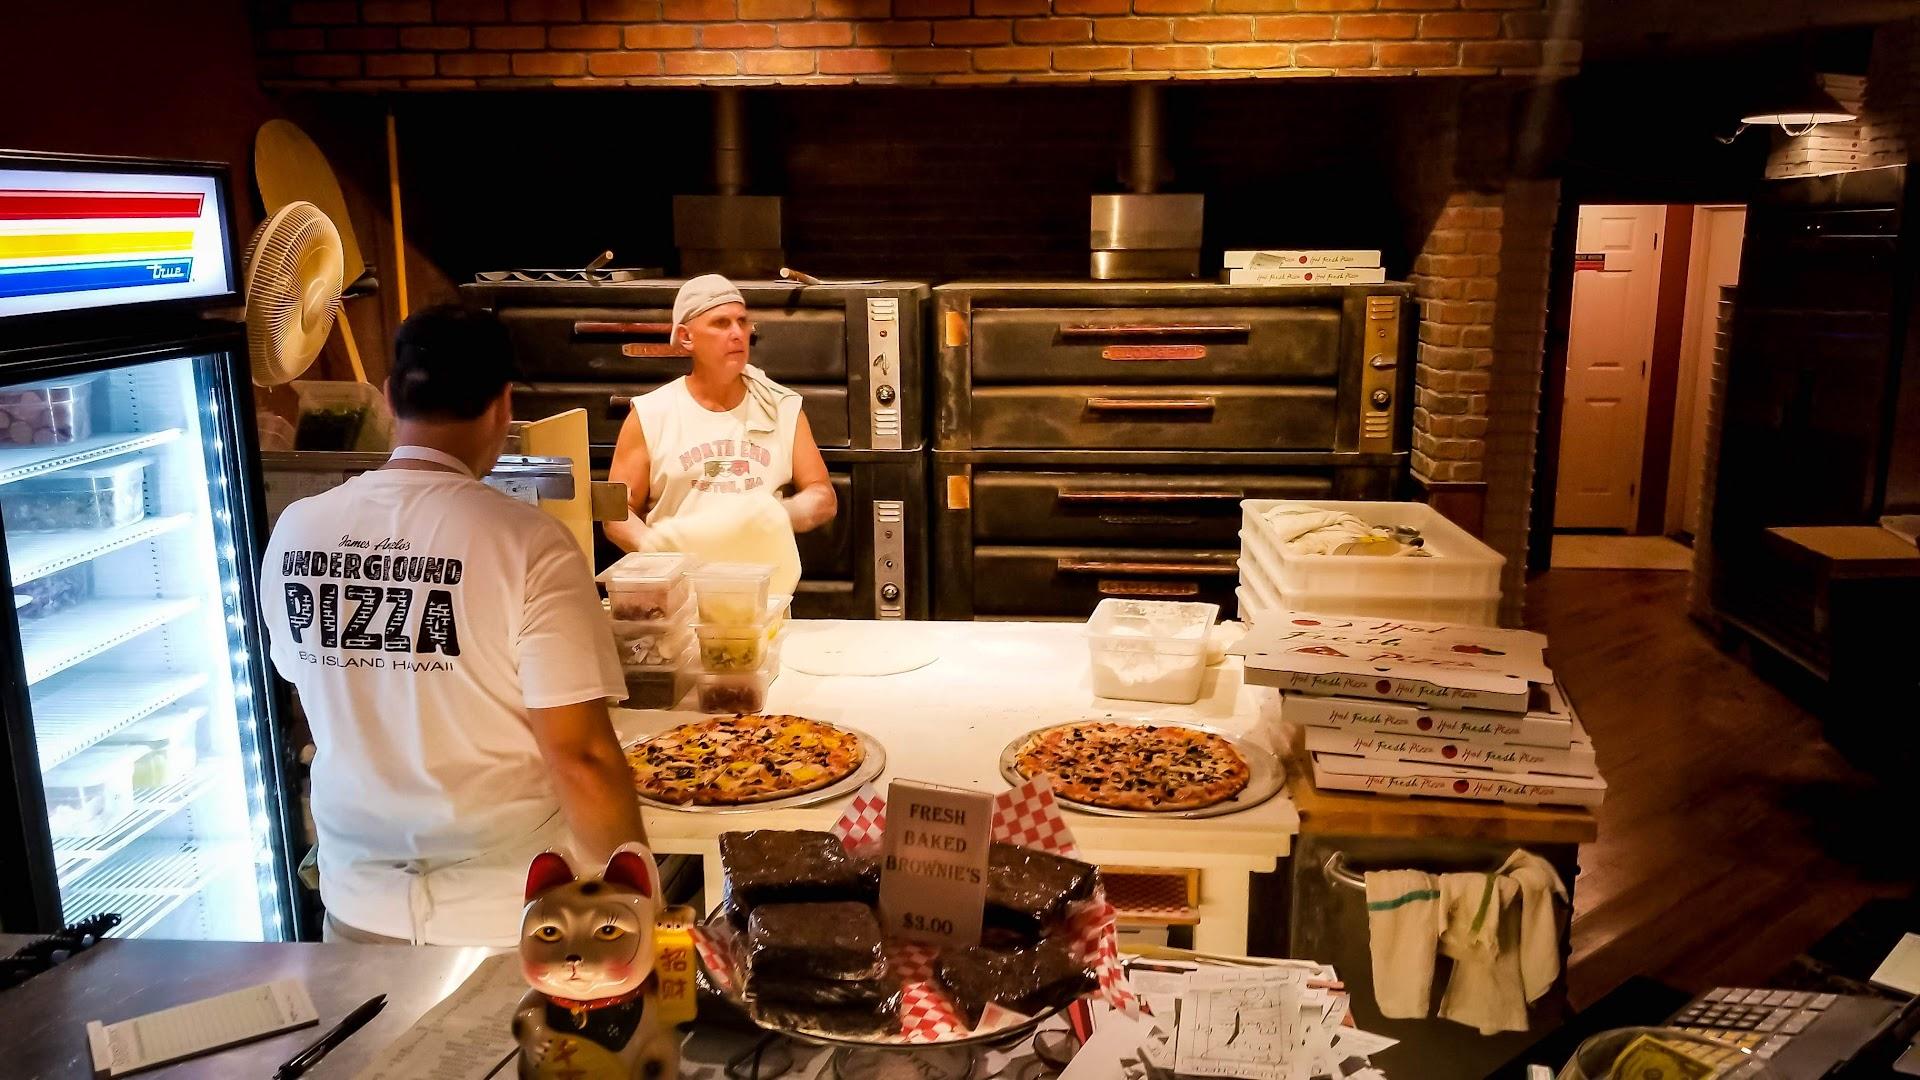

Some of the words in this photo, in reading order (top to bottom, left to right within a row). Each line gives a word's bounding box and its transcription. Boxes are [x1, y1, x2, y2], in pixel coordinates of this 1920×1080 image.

[680, 440, 734, 471] NORTH
[741, 440, 770, 467] END
[745, 477, 763, 490] MA
[338, 534, 370, 549] James
[284, 582, 461, 656] PIZZA
[298, 651, 317, 664] BG
[322, 655, 385, 668] ISLAND
[1311, 676, 1341, 688] Fresh
[1395, 681, 1414, 696] Hot
[1418, 686, 1449, 698] Fresh
[1329, 710, 1348, 723] Hot
[1352, 713, 1380, 724] Fresh
[1384, 714, 1408, 726] Pizza
[1437, 719, 1457, 732] Hot
[1460, 722, 1494, 734] Fresh
[1494, 726, 1520, 735] Pizza
[1354, 738, 1373, 750] Hot
[1376, 741, 1406, 752] Fresh
[1409, 743, 1434, 754] Pizza
[1462, 748, 1480, 762] Hot
[1484, 751, 1516, 762] Fresh
[1519, 752, 1545, 763] Pizza
[1365, 776, 1385, 789] Hot
[1385, 777, 1417, 791] Fresh
[1420, 779, 1446, 790] Pizza
[1474, 782, 1493, 796] Hot
[1495, 784, 1527, 797] Fresh
[910, 803, 967, 825] FRESH
[904, 830, 967, 853] BAKED
[886, 855, 981, 884] BROWNIE'S
[902, 912, 953, 935] $3.00
